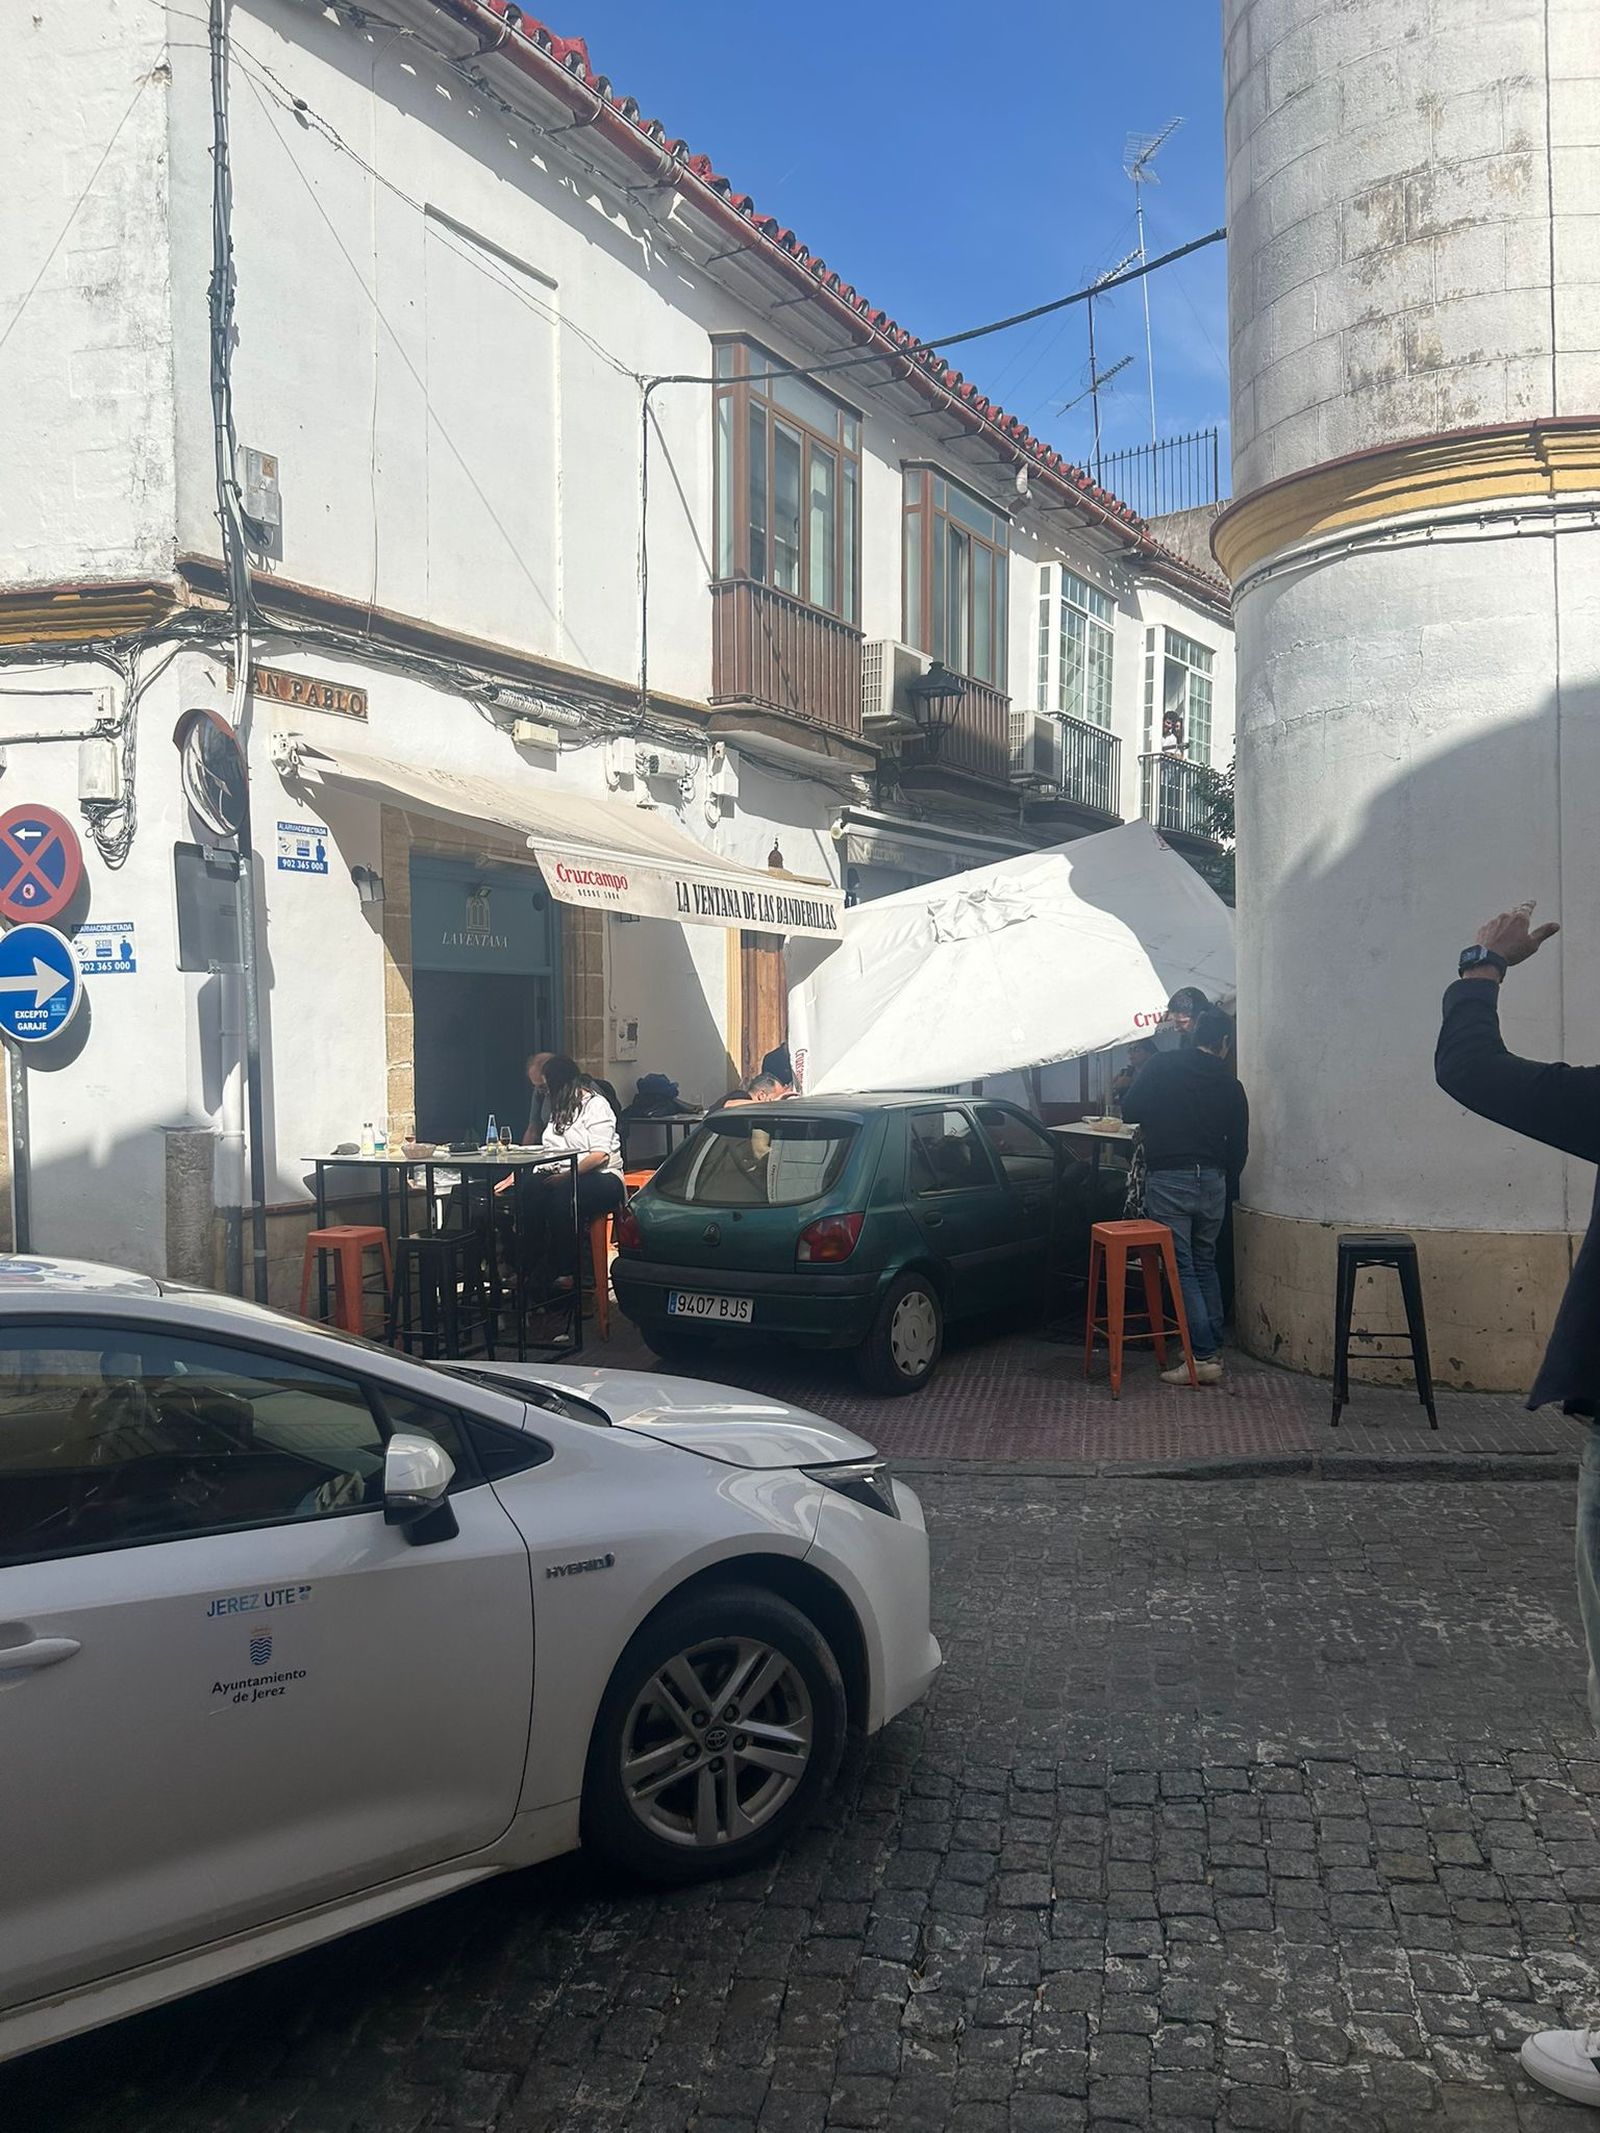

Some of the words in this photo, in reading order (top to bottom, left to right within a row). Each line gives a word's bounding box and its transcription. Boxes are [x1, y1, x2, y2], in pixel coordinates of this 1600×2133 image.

[252, 668, 280, 697] AN
[290, 679, 362, 714] PABLO
[282, 858, 295, 868] 902
[296, 860, 310, 869] 365
[311, 861, 324, 870] 000
[556, 863, 628, 891] Cruzcampo
[675, 881, 690, 913] LA
[692, 883, 742, 919] VENTANA
[741, 890, 757, 920] DE
[757, 893, 775, 922] LAS
[776, 896, 837, 930] BANDERILLAS
[73, 923, 133, 933] ARMACONECTADA
[79, 962, 95, 971] 902
[96, 961, 112, 970] 365
[114, 961, 130, 970] 000
[14, 1010, 49, 1019] EXCEPTO
[1133, 1010, 1173, 1028] Cruz
[17, 1022, 48, 1031] GARAJE
[677, 1295, 715, 1315] 9407
[720, 1299, 748, 1319] BJS
[545, 1558, 605, 1579] HYBRID
[206, 1593, 260, 1617] JEREZ
[264, 1588, 296, 1608] UTE
[211, 1669, 307, 1695] Ayuntamiento
[232, 1691, 249, 1704] de
[250, 1686, 286, 1703] Jerez
